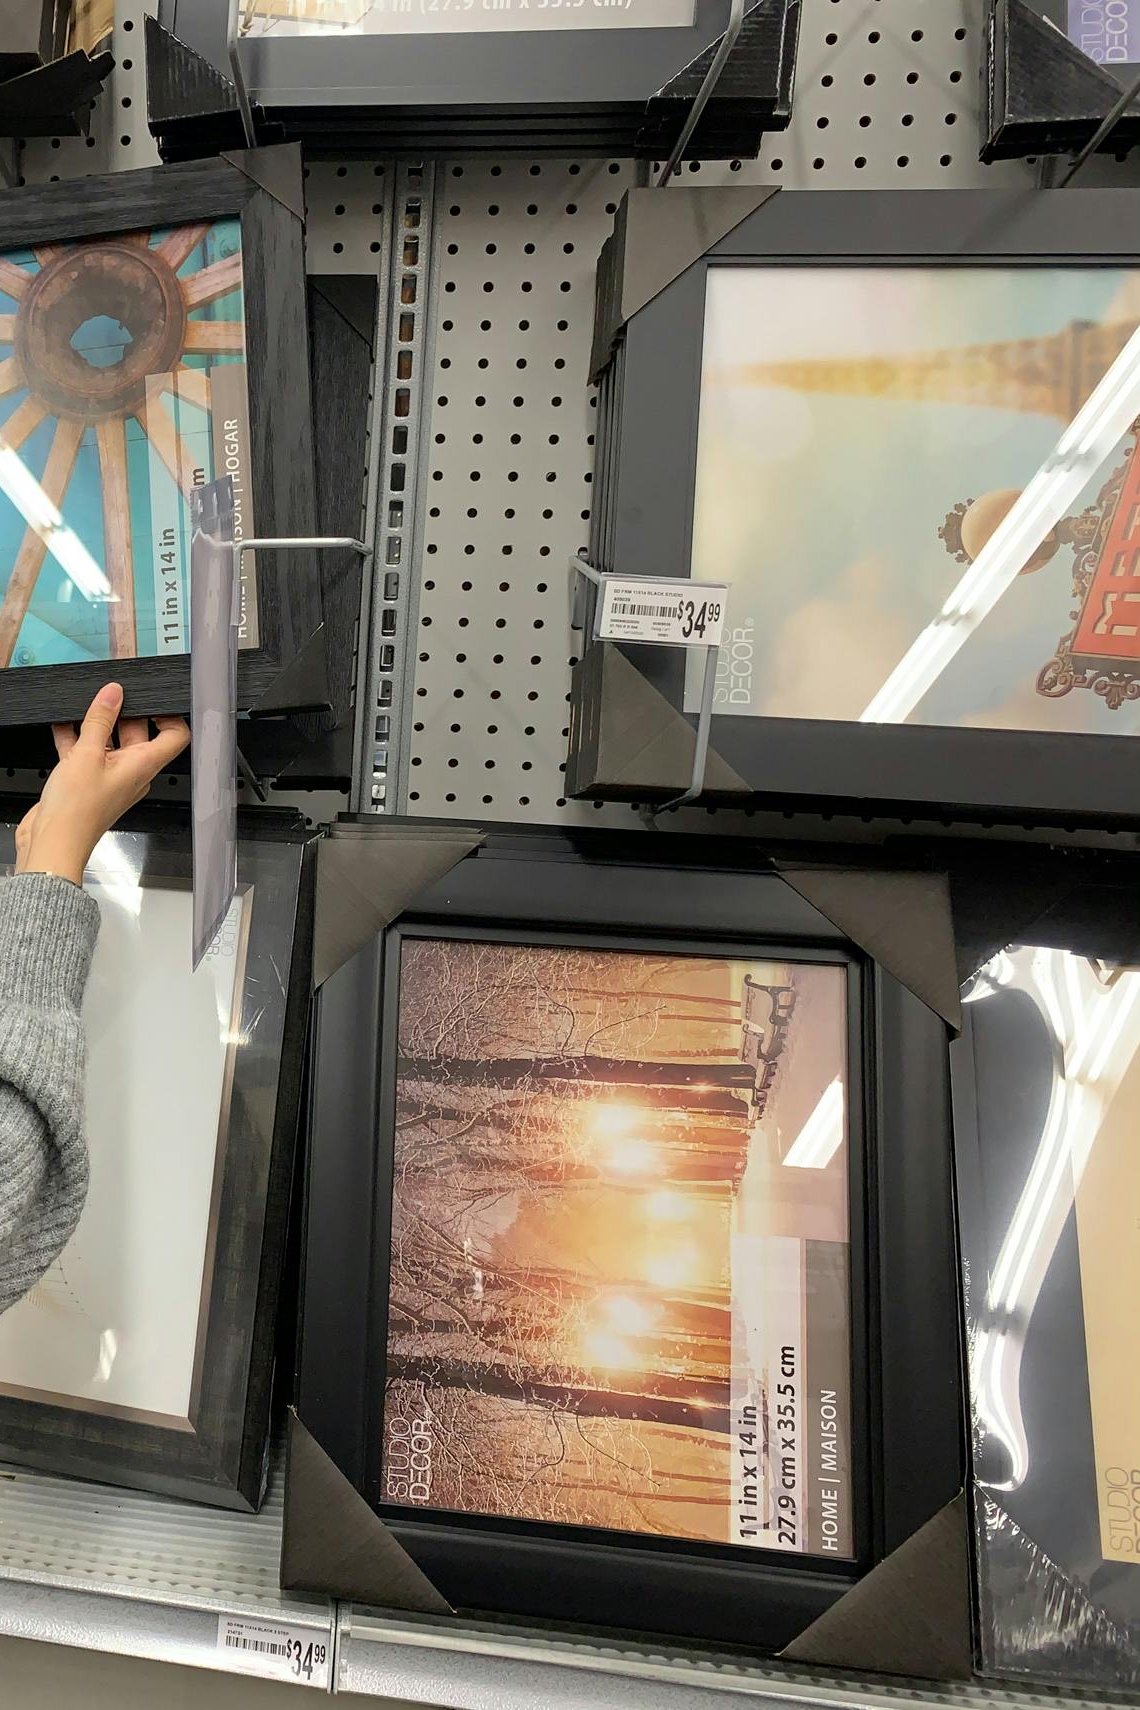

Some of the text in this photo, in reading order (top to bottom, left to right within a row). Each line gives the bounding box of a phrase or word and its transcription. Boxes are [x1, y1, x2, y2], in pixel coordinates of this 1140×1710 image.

[1106, 1, 1128, 61] DECO
[159, 527, 179, 644] 11 in x 14 in
[387, 1417, 411, 1497] STUDIO
[738, 1405, 757, 1538] 11 in x 14 in
[777, 1346, 796, 1546] 27.9 cm x 35.5 cm
[820, 1389, 838, 1471] MAISON
[821, 1488, 838, 1551] HOME
[1105, 1466, 1133, 1552] STUDIO
